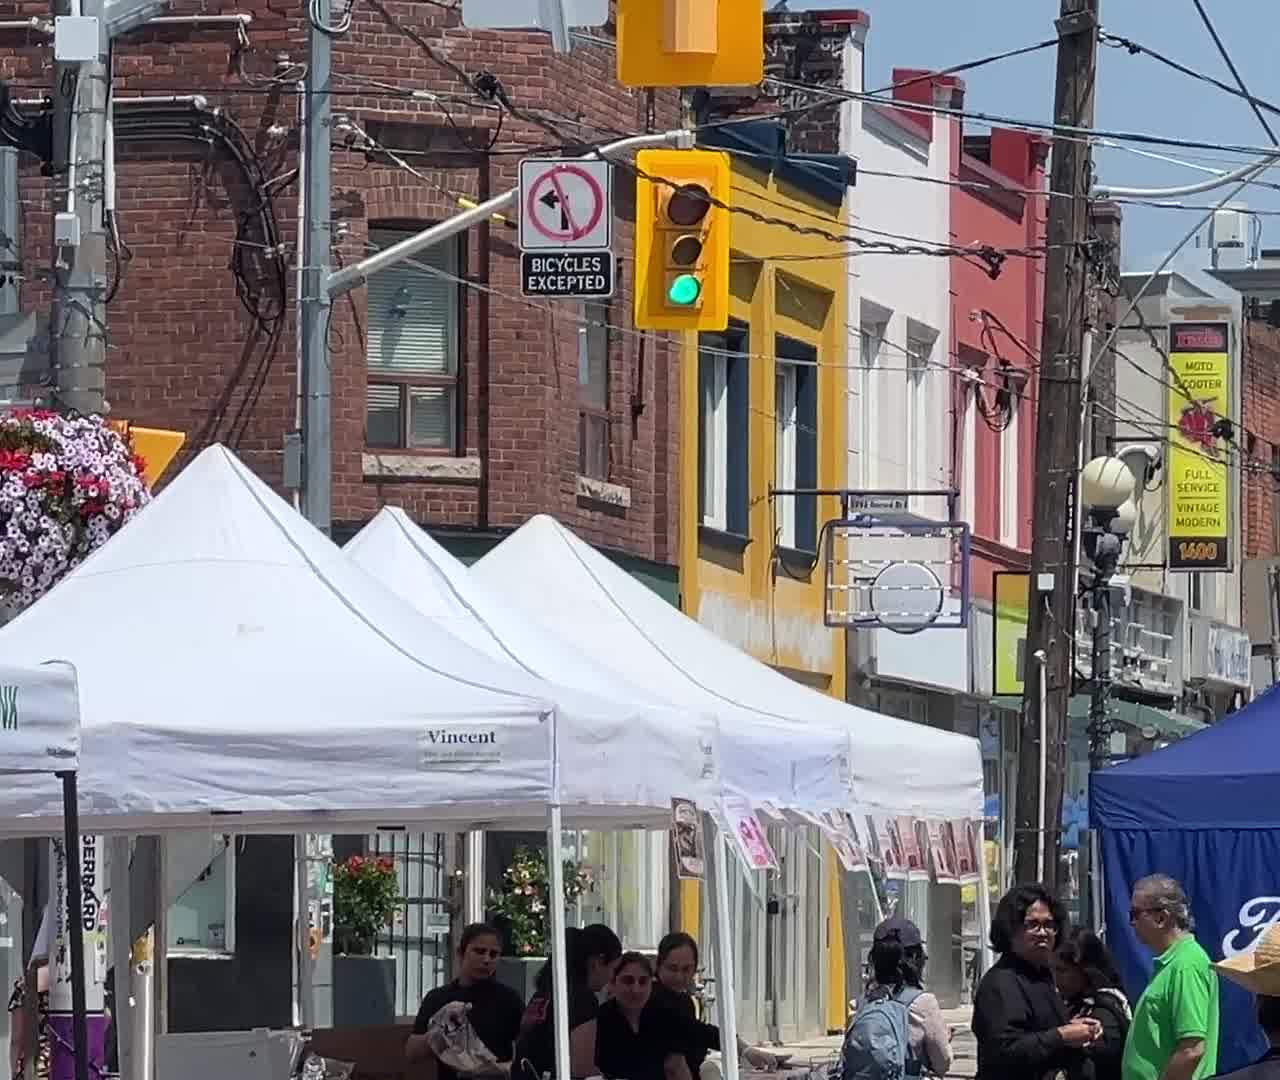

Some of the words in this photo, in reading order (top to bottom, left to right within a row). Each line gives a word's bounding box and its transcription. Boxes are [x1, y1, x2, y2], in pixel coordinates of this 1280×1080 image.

[531, 257, 601, 273] BICYCLES
[528, 275, 606, 290] EXCEPTED
[1185, 361, 1214, 371] MOTO
[1178, 379, 1222, 389] COOTER
[1184, 470, 1212, 481] FULL
[1177, 483, 1221, 493] SERVICE
[1176, 503, 1220, 513] VINTAGE
[1176, 517, 1221, 527] MODERN
[428, 729, 496, 744] Vincent
[82, 835, 96, 931] GERRARD
